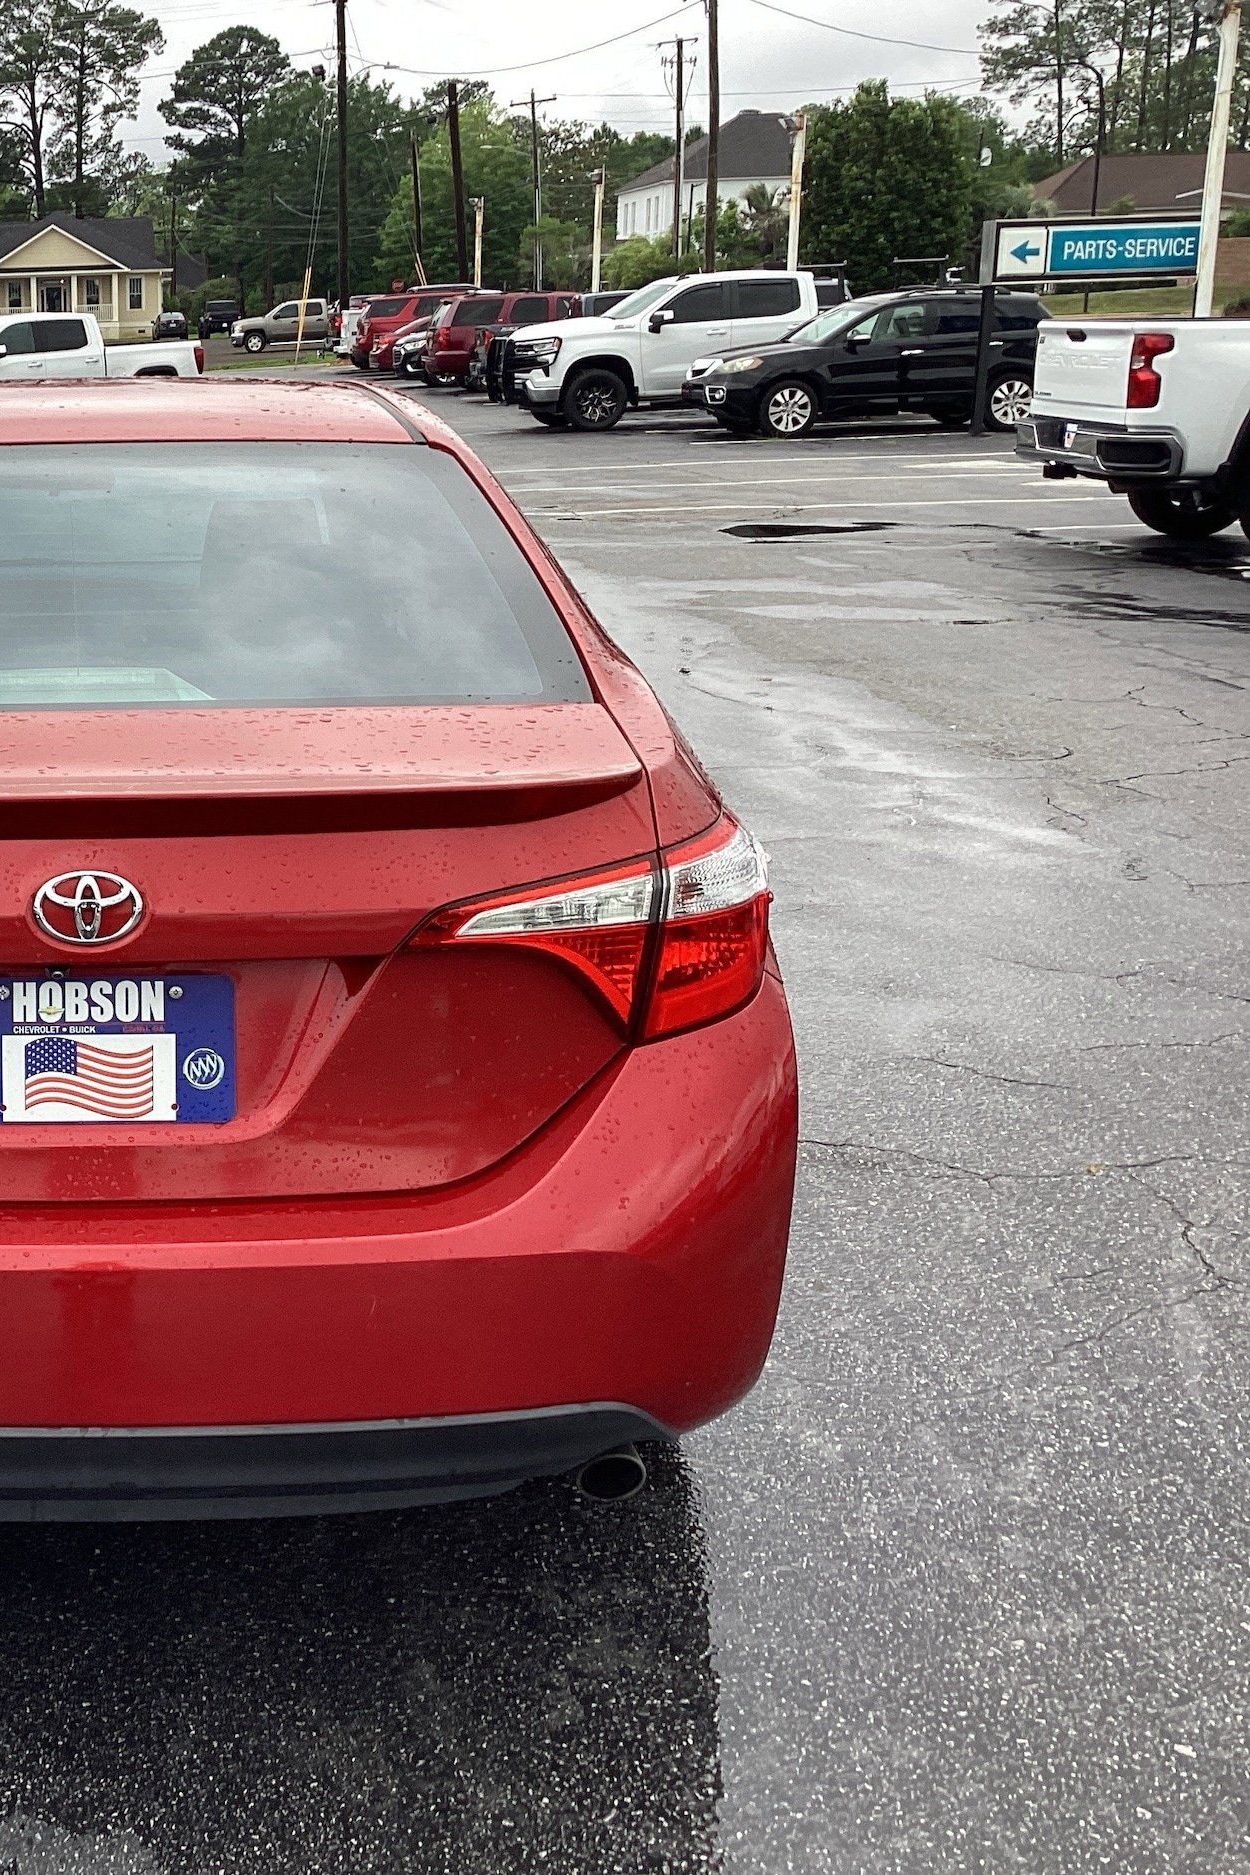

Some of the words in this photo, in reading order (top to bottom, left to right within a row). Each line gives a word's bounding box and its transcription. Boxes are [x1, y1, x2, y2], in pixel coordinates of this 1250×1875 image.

[1063, 237, 1196, 260] PARTS-SERVICE
[12, 980, 165, 1023] HOBSON
[13, 1025, 60, 1034] CHEVROLET
[69, 1025, 96, 1034] BUICK
